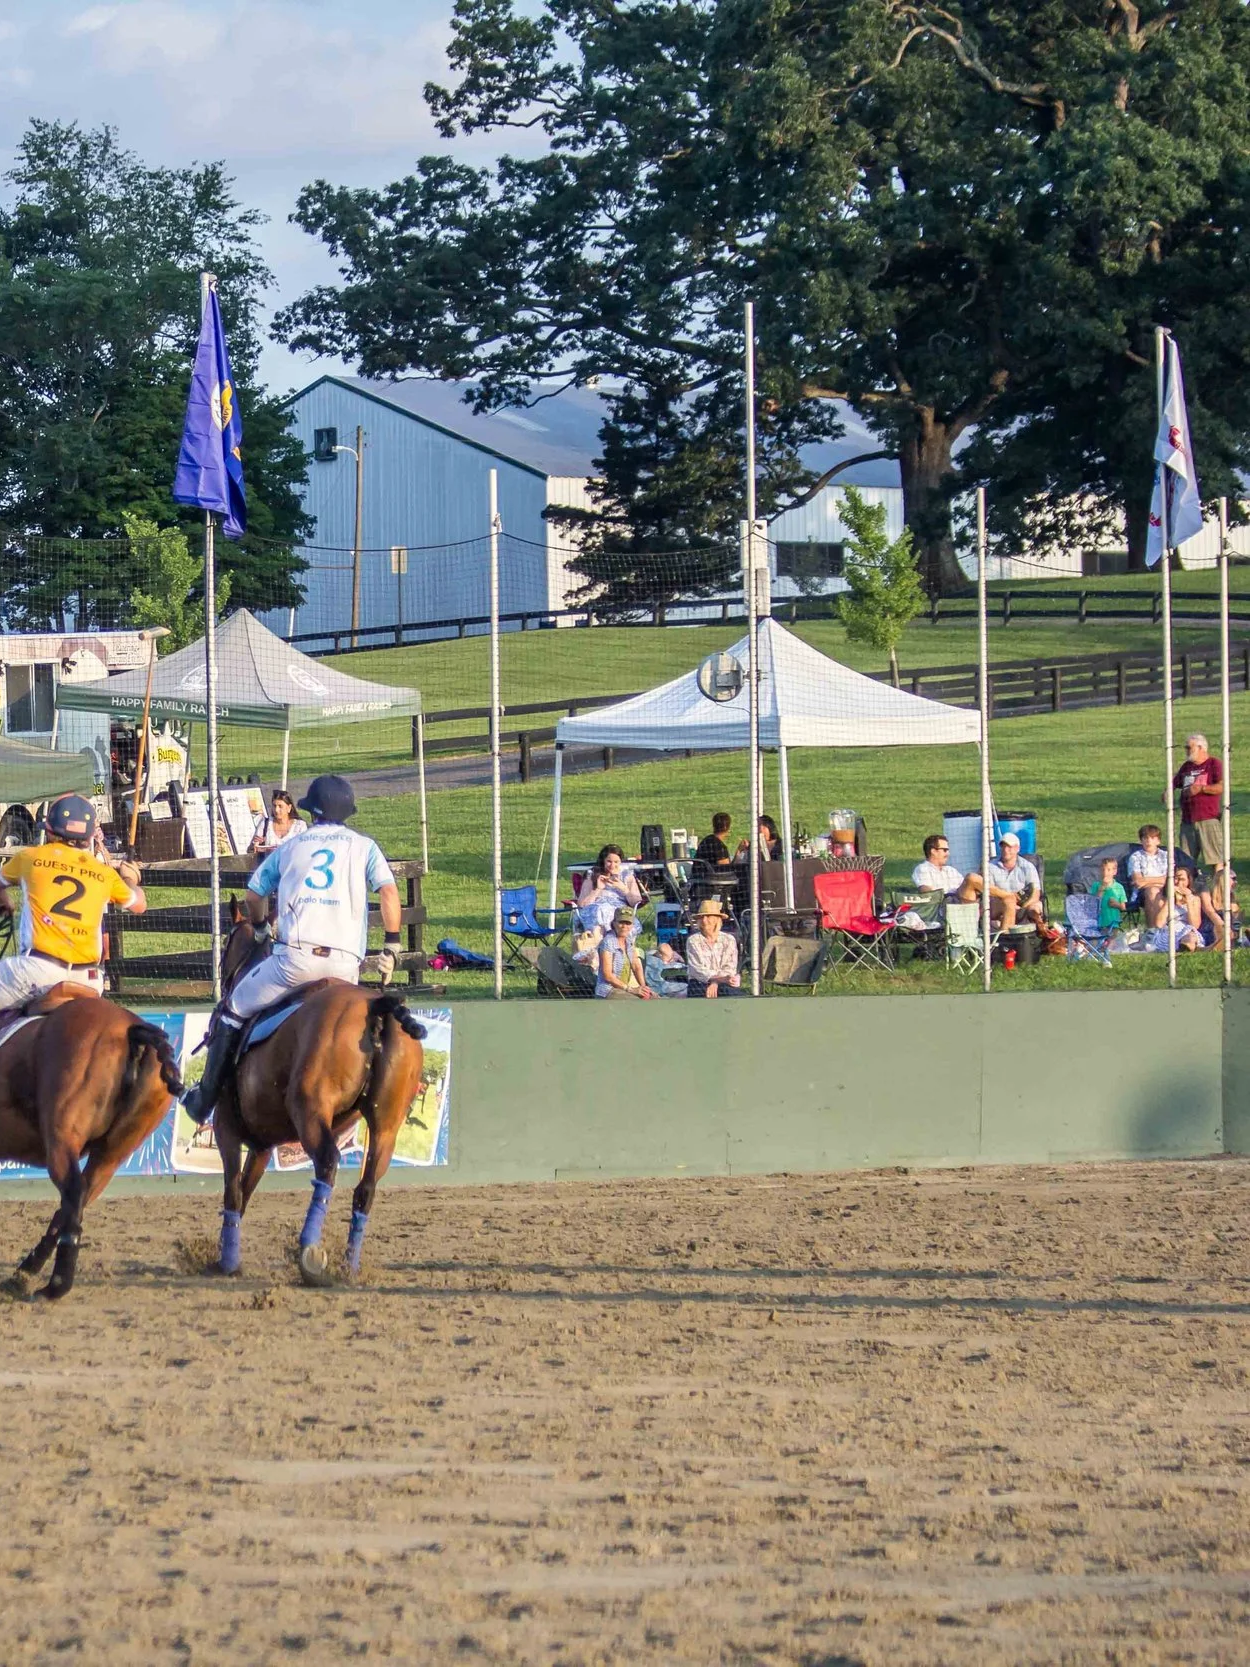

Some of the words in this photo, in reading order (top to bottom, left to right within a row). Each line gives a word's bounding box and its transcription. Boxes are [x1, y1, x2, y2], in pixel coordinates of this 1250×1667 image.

[111, 697, 146, 709] HAPPY
[150, 700, 188, 712] FAMILY
[190, 704, 229, 717] RACH
[32, 858, 76, 873] GUEST
[79, 868, 106, 883] PRO
[304, 848, 336, 891] 3
[49, 874, 87, 922] 2
